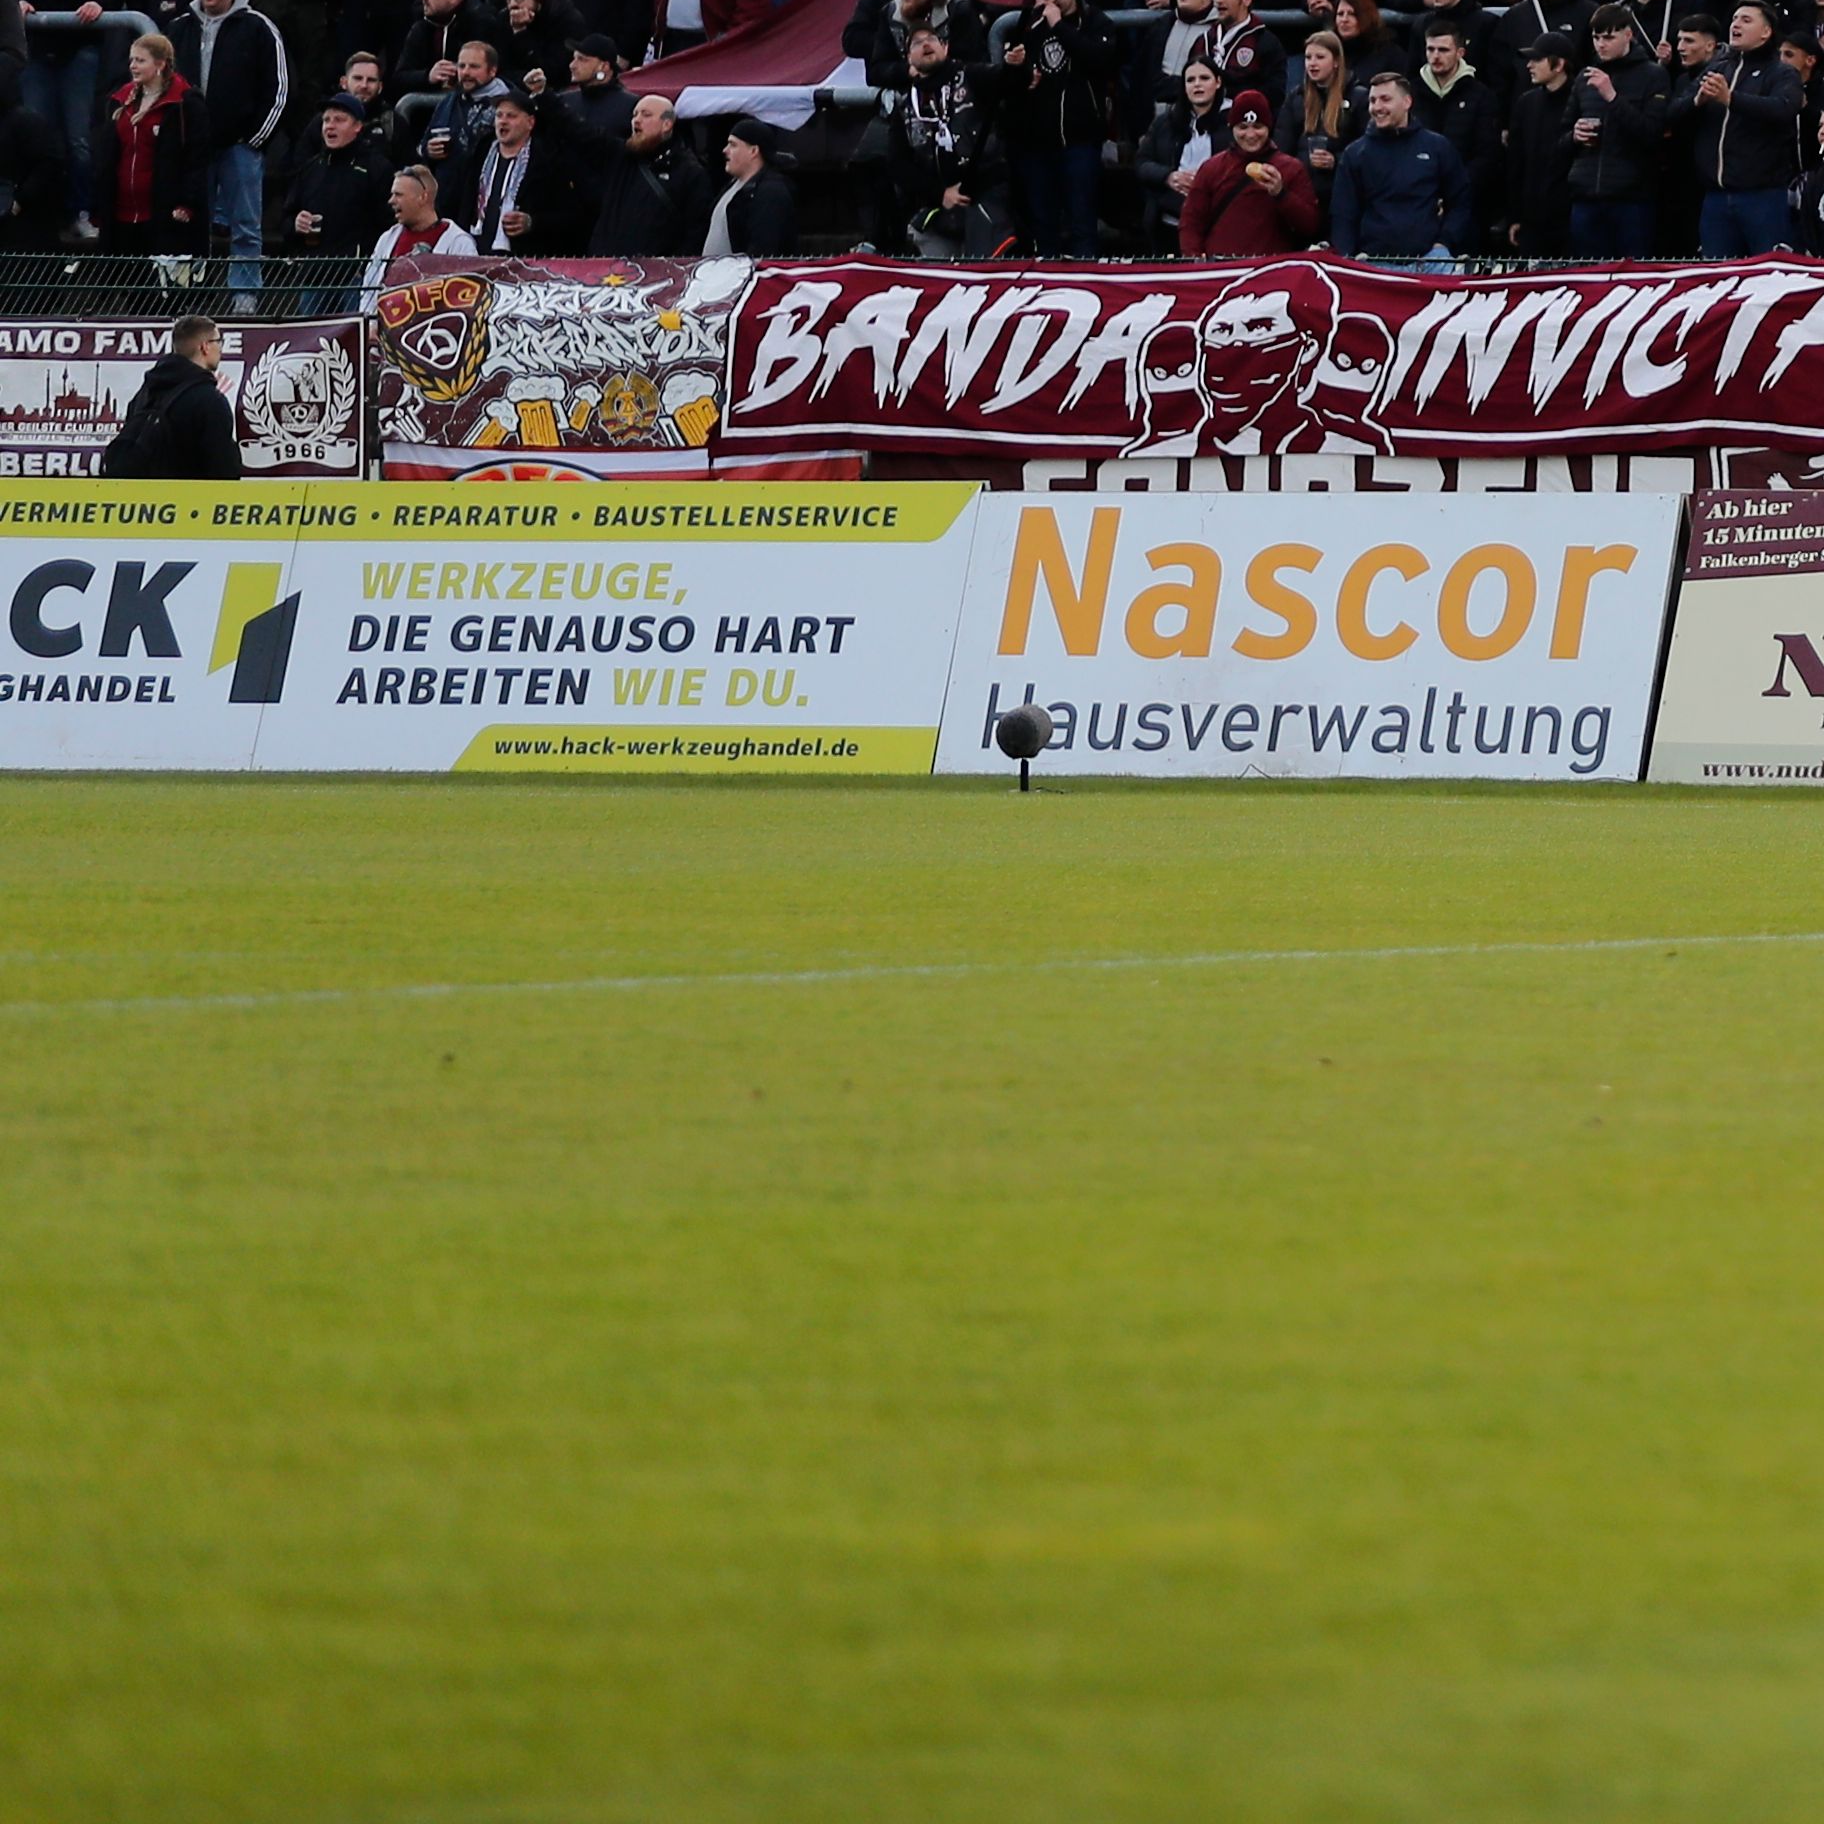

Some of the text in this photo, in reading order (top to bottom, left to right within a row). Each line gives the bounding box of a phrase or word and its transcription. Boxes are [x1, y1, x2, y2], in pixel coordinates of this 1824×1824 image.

[377, 277, 481, 327] BFC
[93, 328, 243, 355] FAME
[732, 281, 1176, 421] BANDA
[18, 422, 63, 433] GEILSTE
[65, 422, 94, 433] CLUB
[96, 422, 117, 433] DER
[1, 452, 103, 477] BERLI
[273, 445, 326, 461] 1966
[212, 504, 358, 526] BERATUNG
[393, 505, 558, 527] REPARATUR
[593, 506, 898, 528] BAUSTELLENSERVICE
[1704, 498, 1793, 520] Ab hier
[1703, 527, 1731, 545] 15
[1699, 551, 1819, 569] Falkenberger
[361, 561, 688, 606] WERKZEUGE,
[996, 505, 1640, 662] Nascor
[10, 559, 198, 658] CK
[348, 615, 857, 654] DIE GENAUSO HART
[0, 673, 176, 703] GHANDEL
[336, 666, 810, 707] ARBEITEN WIE DU.
[981, 682, 1613, 774] Hausverwaltung
[494, 735, 860, 762] www.hack-werkzeughandel.de
